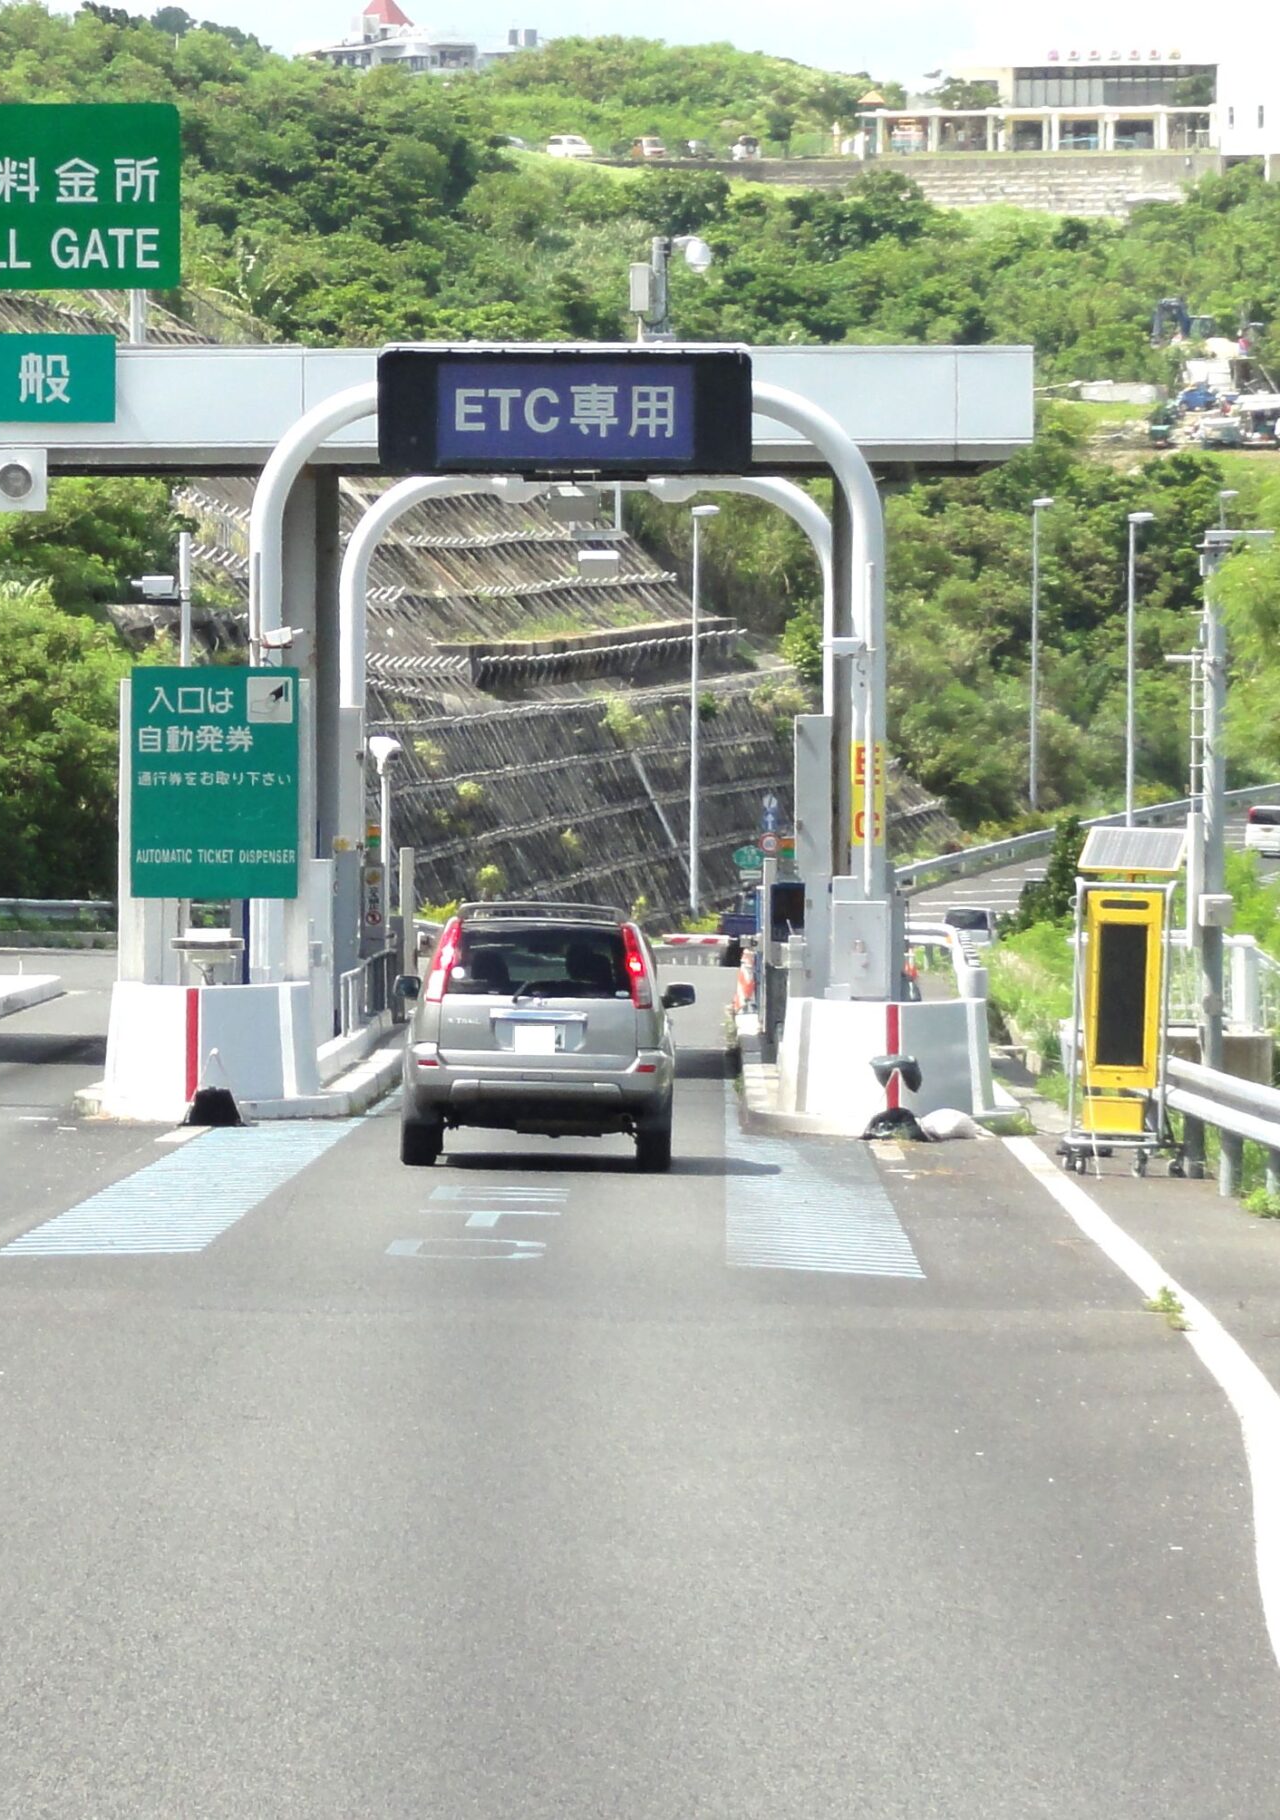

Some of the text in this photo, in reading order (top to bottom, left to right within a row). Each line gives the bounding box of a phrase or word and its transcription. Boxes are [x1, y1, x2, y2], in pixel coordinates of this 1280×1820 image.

[51, 228, 160, 270] GATE
[455, 383, 675, 438] ETC専用
[148, 686, 234, 714] 入口は
[138, 725, 254, 752] 自動発券
[135, 848, 296, 864] AUTOMATIC TICKET DISPENSER
